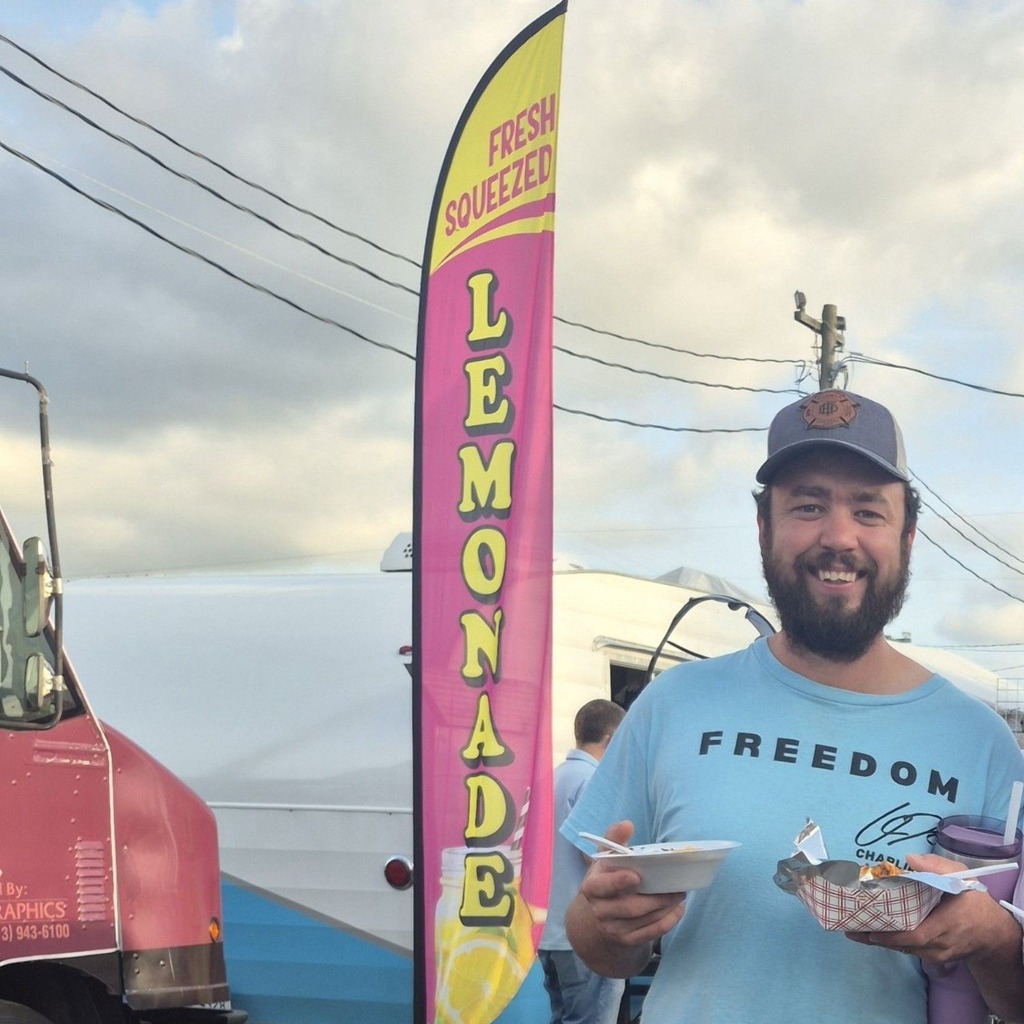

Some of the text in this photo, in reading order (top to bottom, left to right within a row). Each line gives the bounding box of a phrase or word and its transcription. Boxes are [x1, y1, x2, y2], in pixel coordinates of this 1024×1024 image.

[489, 93, 556, 167] FRESH
[445, 144, 553, 237] SQUEEZED
[457, 269, 516, 928] LEMONADE
[699, 730, 959, 804] FREEDOM
[0, 901, 66, 919] APHICS
[6, 882, 28, 899] By:
[16, 923, 70, 940] 943-6100
